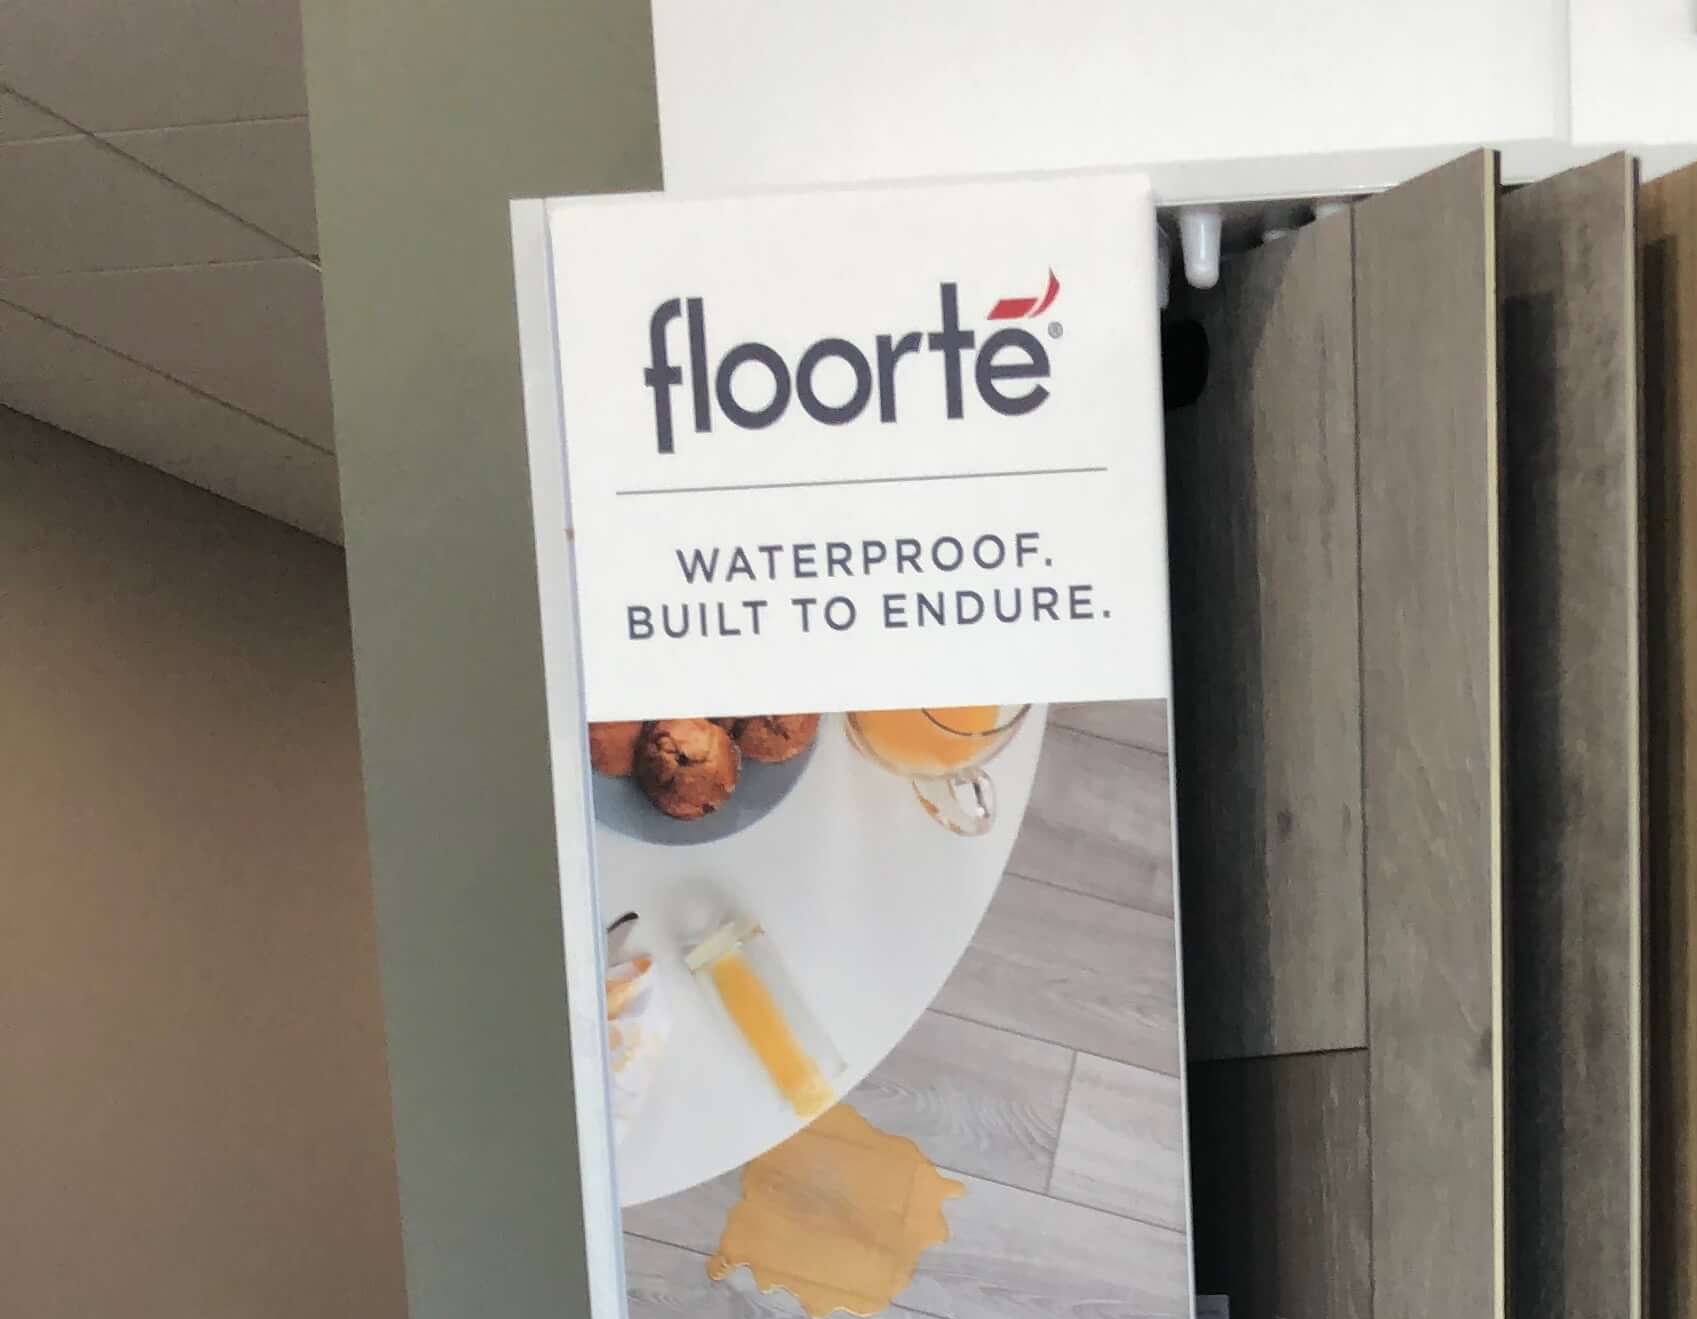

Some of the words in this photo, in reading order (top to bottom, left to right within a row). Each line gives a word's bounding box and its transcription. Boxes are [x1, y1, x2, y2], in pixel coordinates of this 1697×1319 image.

[677, 534, 1053, 584] WATERPROOF.
[628, 600, 767, 639] BUILT
[792, 595, 856, 632] TO
[884, 586, 1111, 627] ENDURE.
